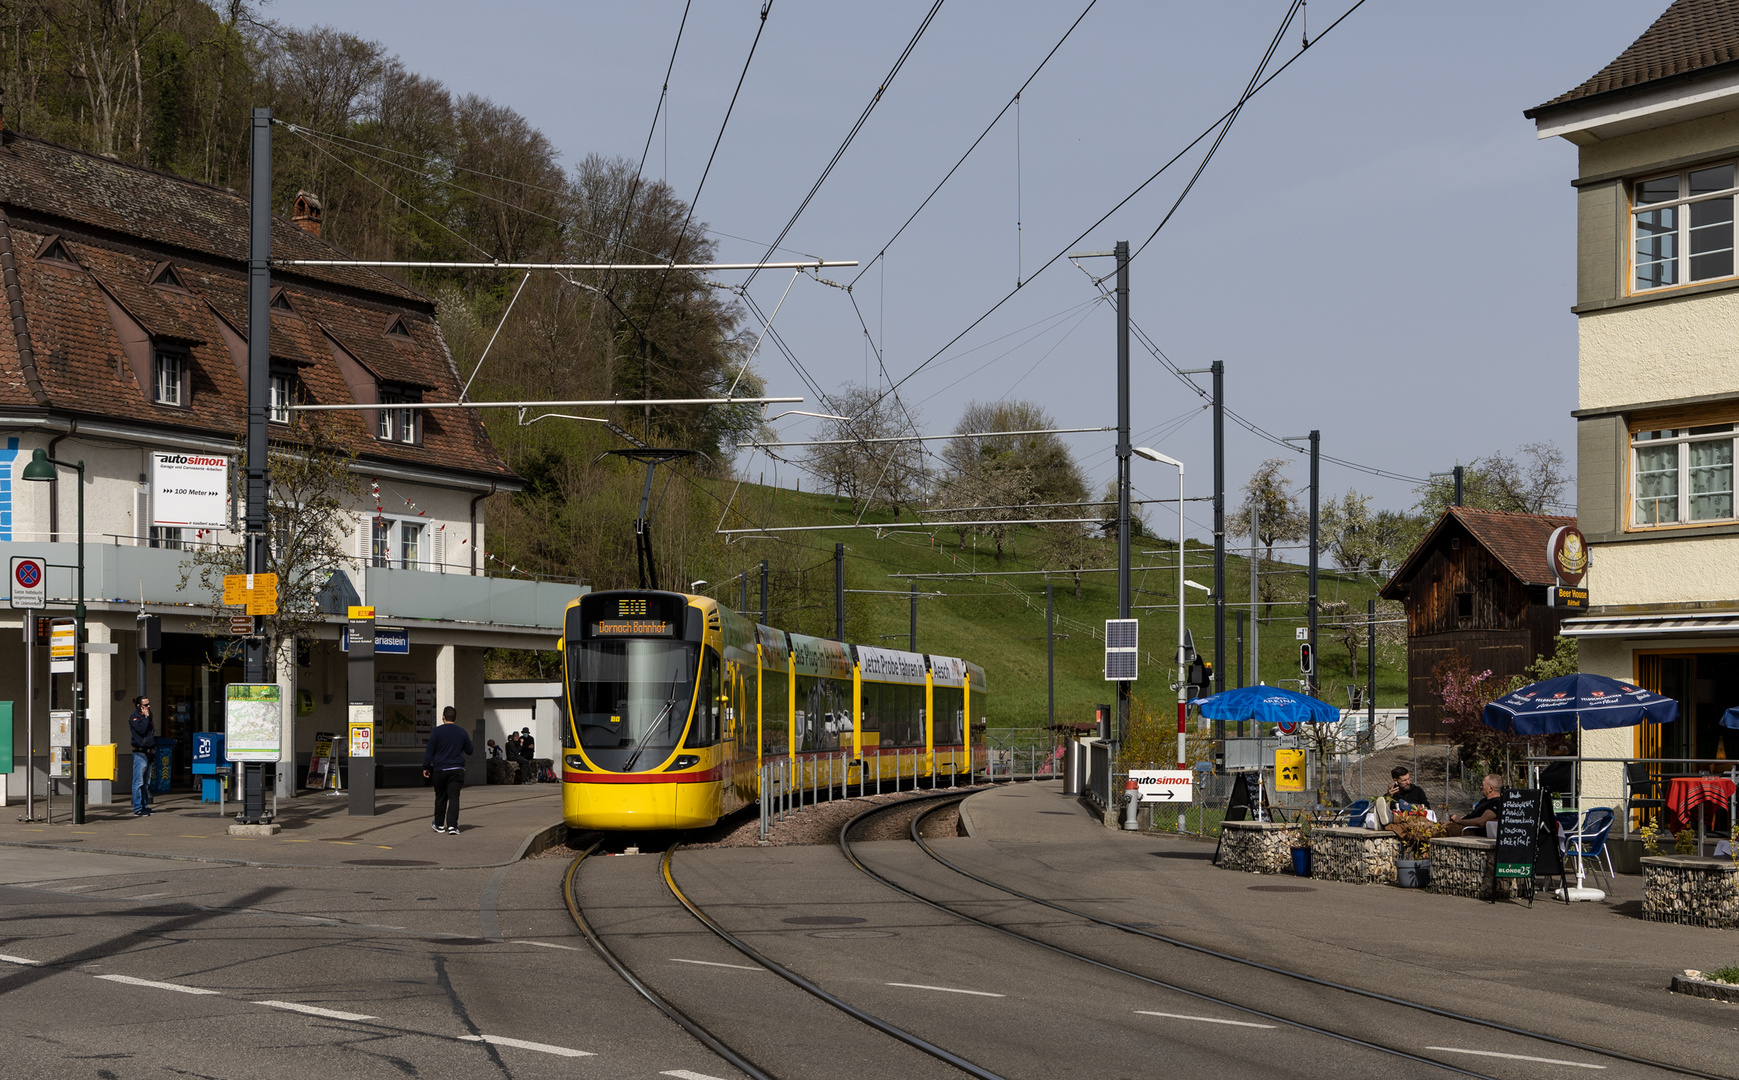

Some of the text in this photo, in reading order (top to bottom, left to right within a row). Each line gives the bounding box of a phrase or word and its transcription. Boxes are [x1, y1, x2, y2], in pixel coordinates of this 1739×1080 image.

[155, 455, 226, 467] autosimon
[1558, 588, 1587, 599] Beer House
[599, 621, 666, 633] Dornach Bahnhof
[375, 634, 406, 646] ariastein
[864, 653, 924, 677] Jetzt Probe fahren in
[933, 660, 950, 679] Aesch
[199, 738, 211, 754] 20
[1280, 756, 1291, 765] 30
[1129, 776, 1192, 785] utosimon
